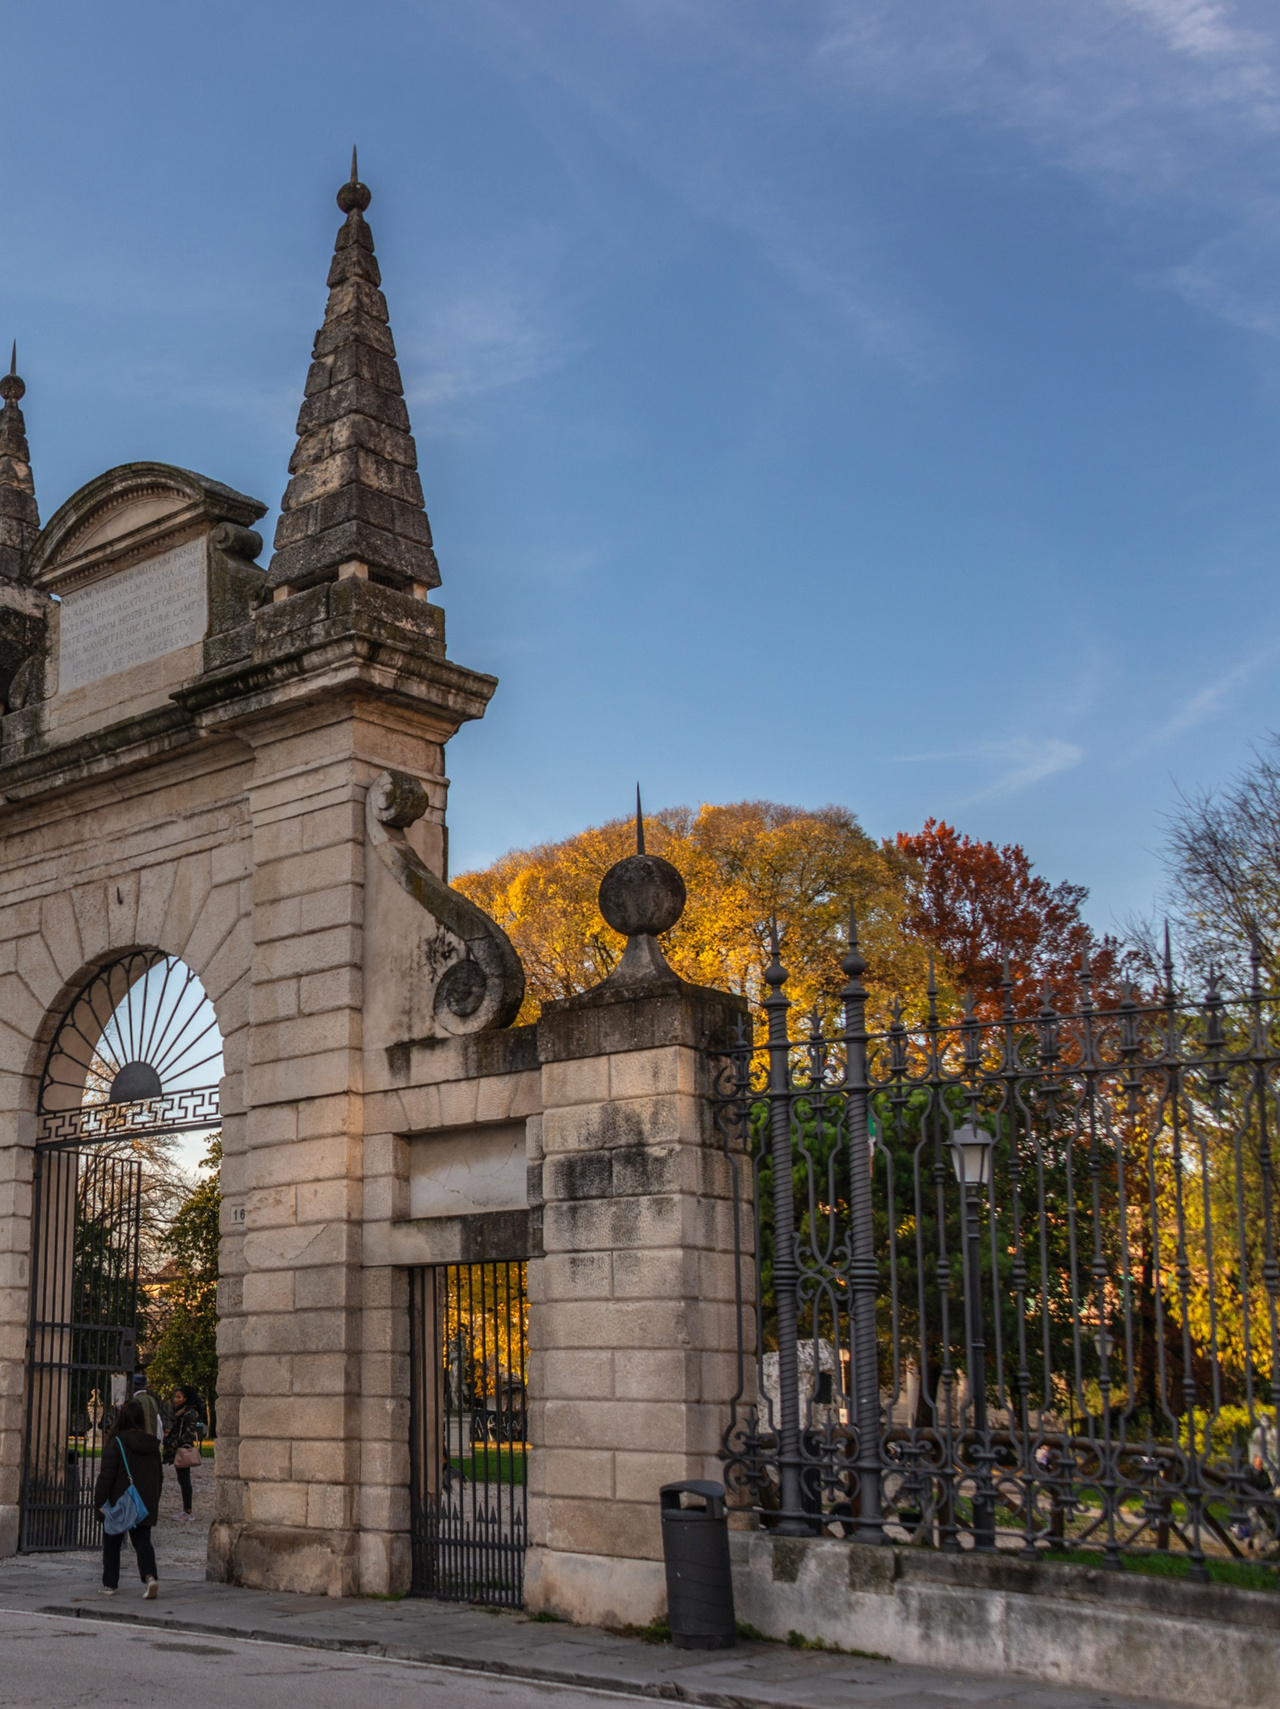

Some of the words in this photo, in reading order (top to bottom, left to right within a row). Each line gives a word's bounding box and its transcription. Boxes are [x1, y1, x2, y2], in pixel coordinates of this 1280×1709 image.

[136, 557, 171, 577] ADITVM
[174, 542, 205, 561] PANDIT
[73, 594, 115, 617] ALOYSIVS
[118, 569, 174, 597] VALMARANA
[83, 620, 116, 640] GRADVM
[119, 607, 147, 626] HOSPES
[151, 601, 161, 612] ET
[163, 582, 206, 607] OBLECTARE
[97, 592, 151, 621] PROPAGATOR
[154, 569, 206, 597] SPLENDORIS
[83, 631, 123, 652] MAVORTIS
[126, 623, 140, 636] HIC
[173, 597, 205, 617] CAMPVS
[127, 650, 141, 664] HIC
[147, 632, 189, 656] ACCESSVS
